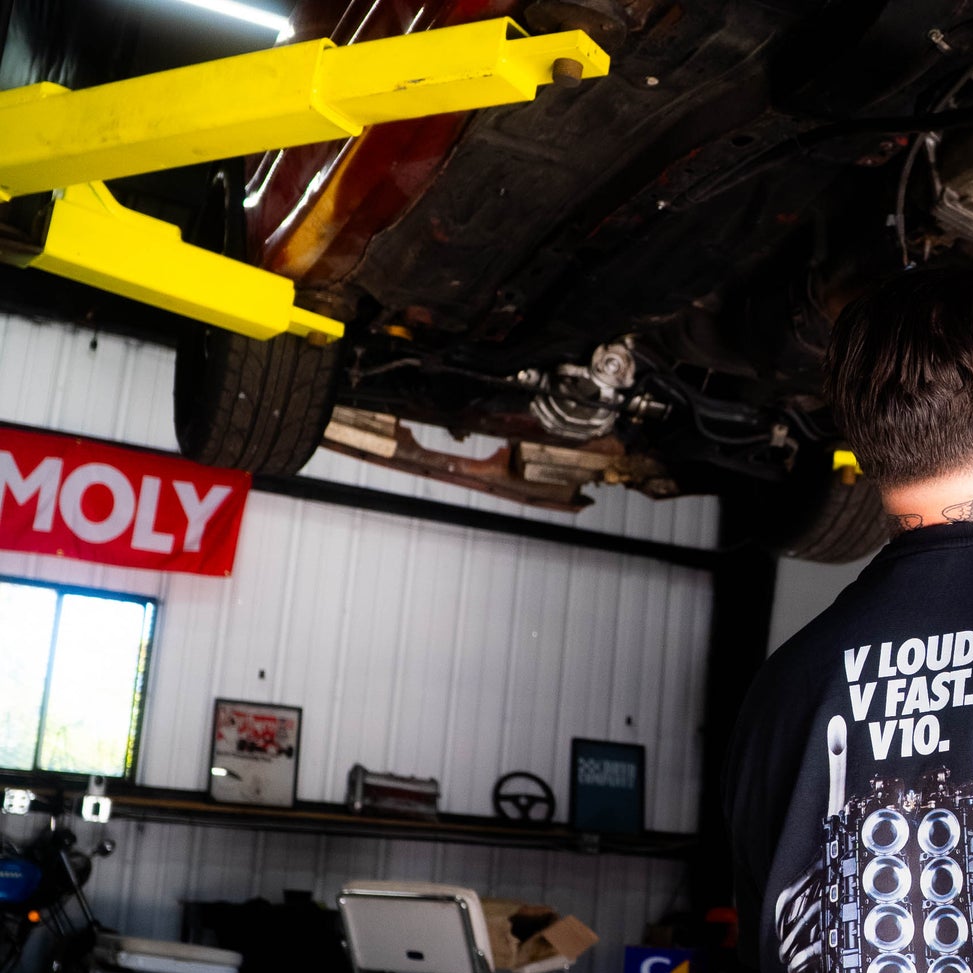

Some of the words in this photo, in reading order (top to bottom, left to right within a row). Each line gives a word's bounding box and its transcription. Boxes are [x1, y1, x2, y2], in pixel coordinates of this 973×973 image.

[0, 450, 233, 554] MOLY
[844, 644, 872, 683] V
[849, 681, 878, 722] V
[868, 714, 950, 761] V10.
